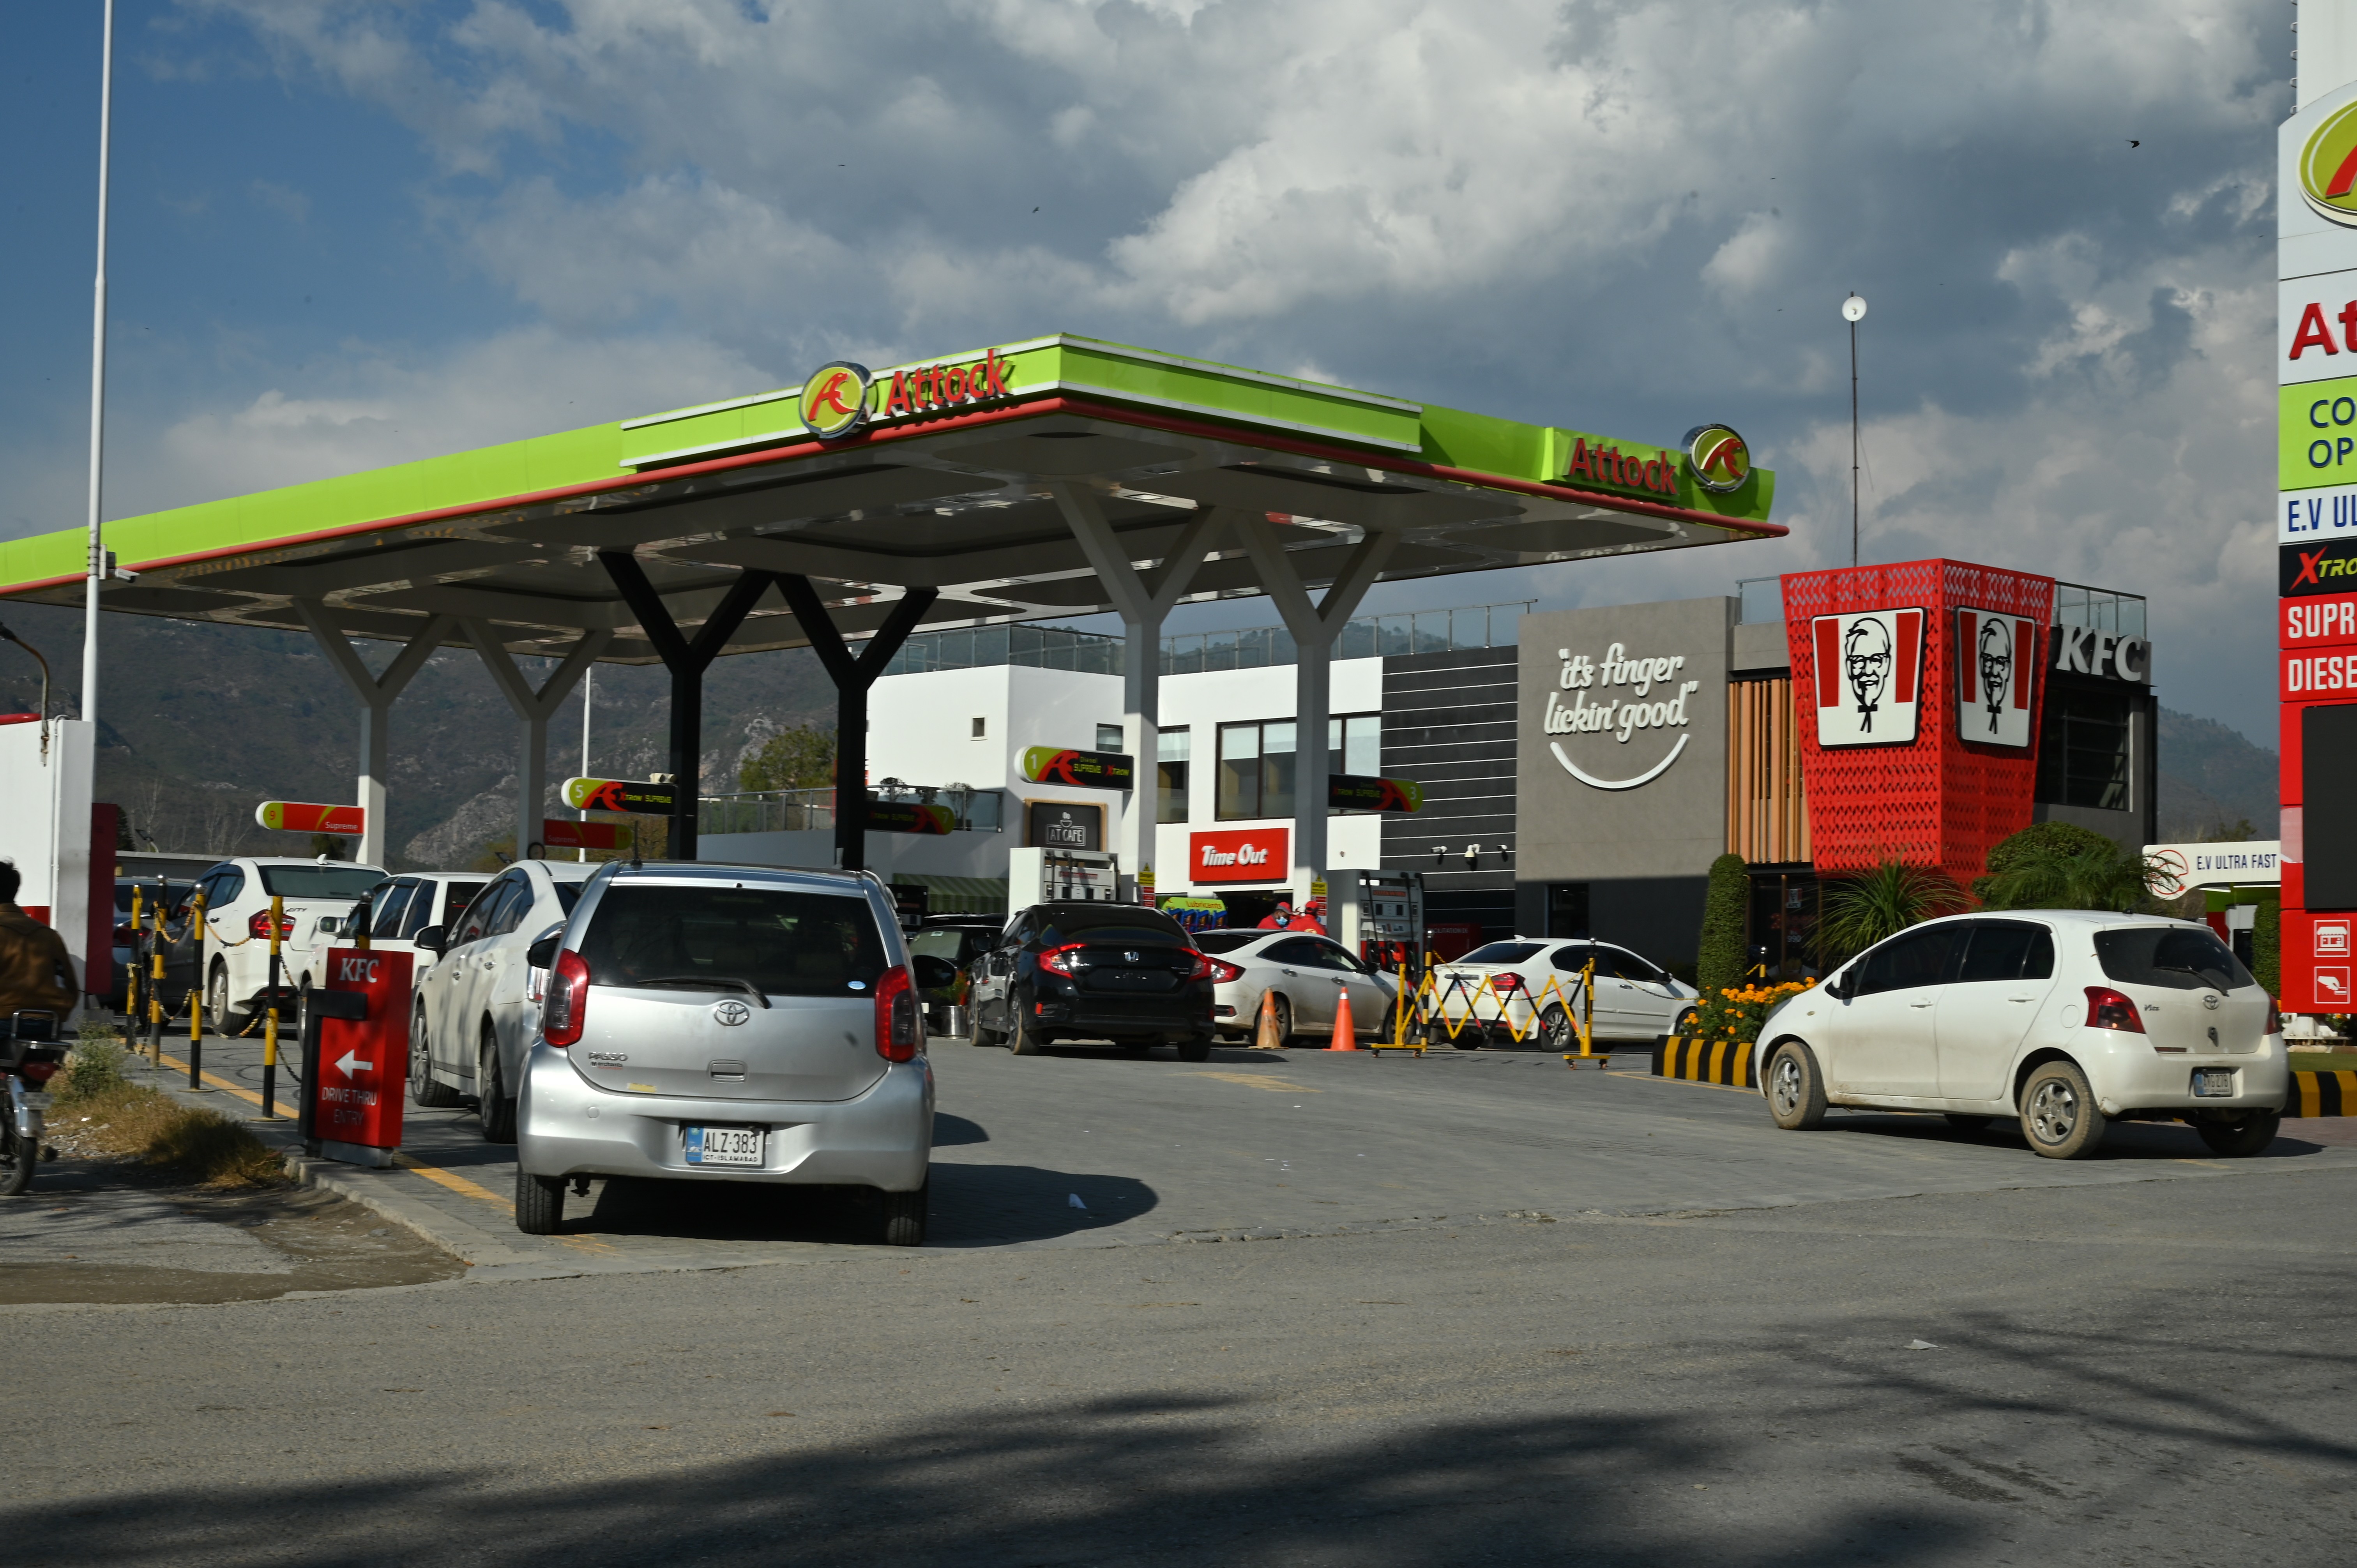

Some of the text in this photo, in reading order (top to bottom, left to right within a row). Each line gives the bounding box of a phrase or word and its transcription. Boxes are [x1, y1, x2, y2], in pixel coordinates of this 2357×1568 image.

[885, 349, 1010, 417] Attock
[2310, 396, 2356, 428] CO
[2309, 437, 2354, 468] OP
[1568, 437, 1677, 494] Attock
[2288, 498, 2322, 532] E.V
[2288, 602, 2355, 639] SUPR
[2055, 625, 2142, 682] KFC
[1599, 643, 1685, 696] finger
[2288, 655, 2357, 692] DIESE
[1544, 690, 1619, 735] lickin'
[1030, 754, 1037, 770] 1
[1074, 763, 1102, 774] SUPREME
[575, 785, 584, 798] 5
[645, 795, 672, 804] SUPREME
[1409, 786, 1417, 800] 3
[269, 810, 276, 820] 9
[942, 812, 949, 824] 7
[325, 821, 358, 830] Supreme
[1050, 828, 1083, 842] AT CAFE
[547, 835, 578, 844] Supreme
[1201, 843, 1269, 867] Time Out
[2197, 853, 2277, 870] E.V ULTRA FAST
[1186, 901, 1223, 909] Lubricants
[339, 957, 379, 983] KFC
[588, 1052, 629, 1061] PASSO
[322, 1086, 377, 1106] DRIVE THRU
[334, 1109, 364, 1125] ENTRY
